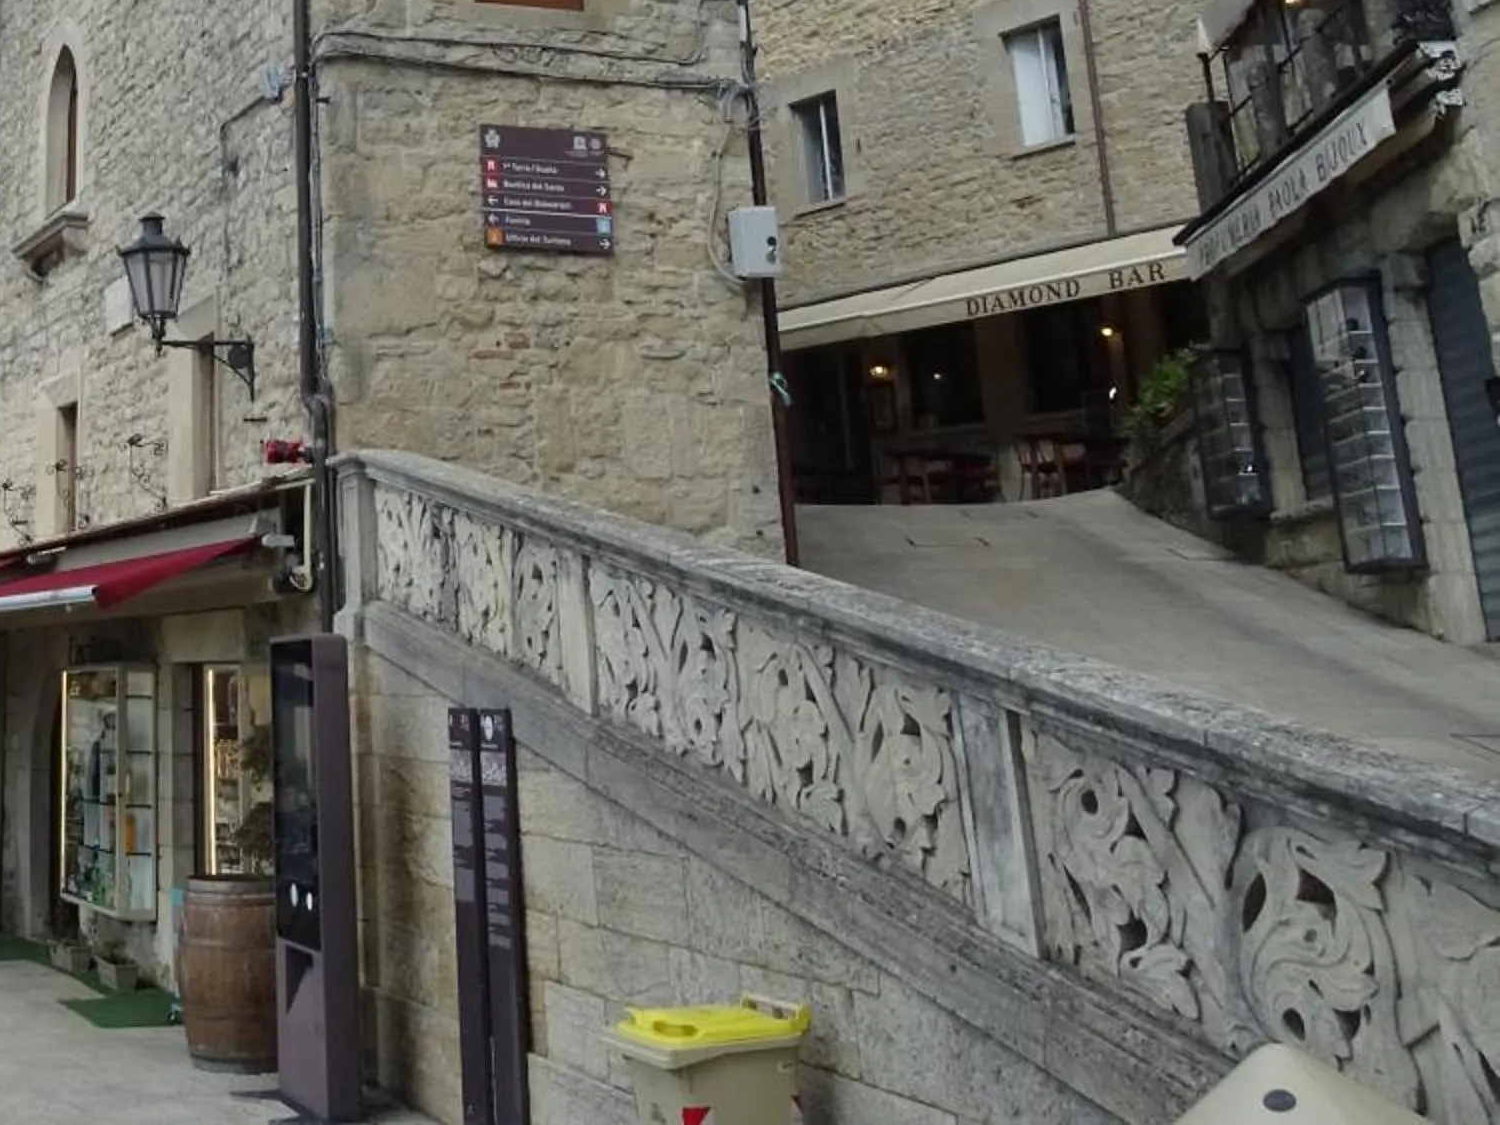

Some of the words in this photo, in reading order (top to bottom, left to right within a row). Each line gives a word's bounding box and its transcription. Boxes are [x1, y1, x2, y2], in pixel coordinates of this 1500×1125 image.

[1267, 168, 1310, 218] PAOLA
[1314, 121, 1369, 183] BIJOUX
[965, 278, 1081, 317] DIAMOND
[1107, 261, 1165, 290] BAR
